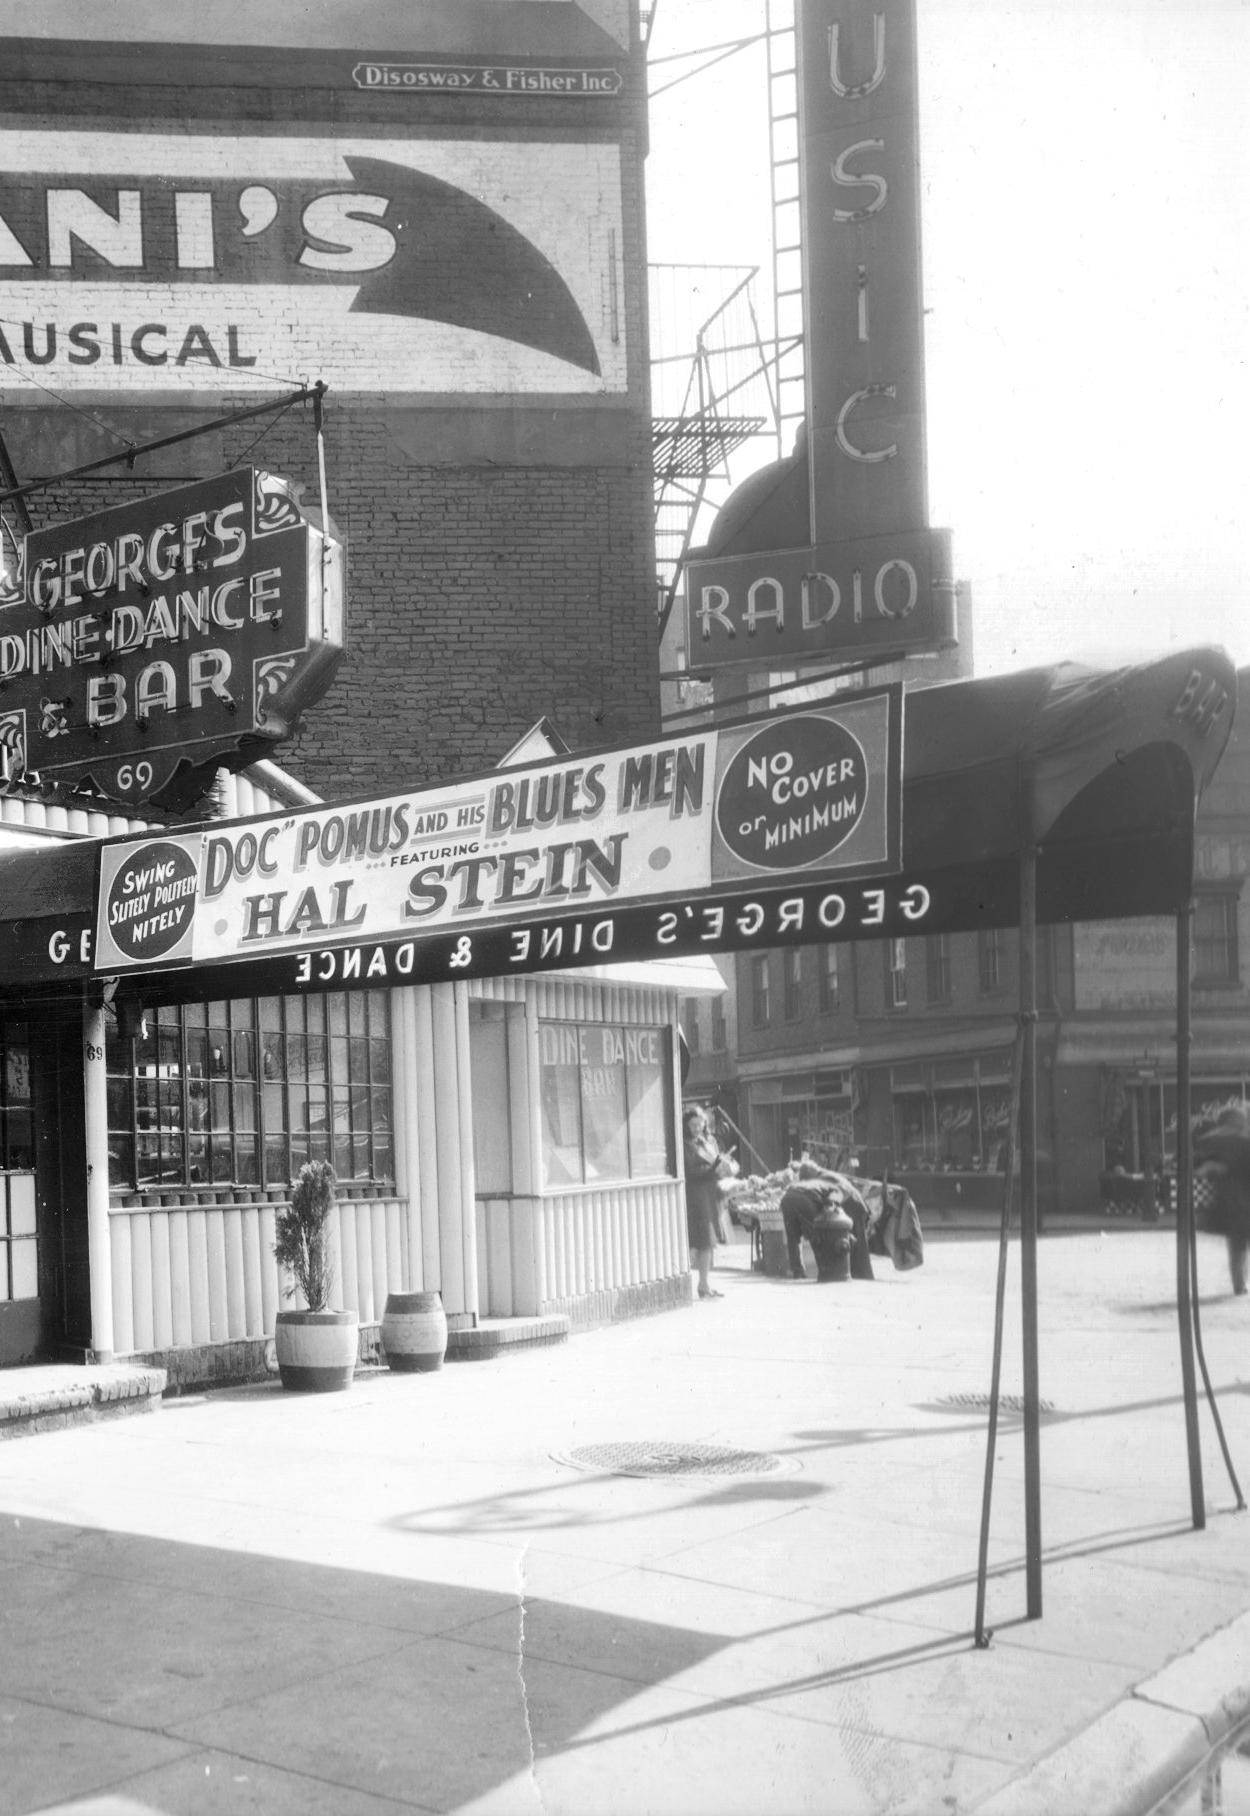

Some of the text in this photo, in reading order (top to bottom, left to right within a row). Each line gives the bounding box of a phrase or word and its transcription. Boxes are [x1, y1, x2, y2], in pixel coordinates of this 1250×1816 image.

[366, 66, 613, 91] Disosway & Fisher Inc
[696, 560, 919, 642] RADIO
[37, 647, 235, 738] & BAR
[116, 761, 154, 792] 69
[746, 751, 794, 790] NO
[771, 757, 857, 804] COVER
[296, 802, 412, 873] POMUS
[413, 811, 449, 836] AND
[456, 804, 486, 827] HIS
[486, 763, 607, 840] BLUES
[617, 742, 706, 821] MEN
[738, 814, 767, 836] or
[390, 841, 480, 868] FEATURING
[122, 859, 177, 897] SWING
[237, 832, 630, 947] HAL STEIN
[109, 890, 151, 927] SLITELY
[131, 905, 185, 944] NITELY
[86, 1044, 103, 1062] 69
[541, 1025, 659, 1066] DINE DANCE
